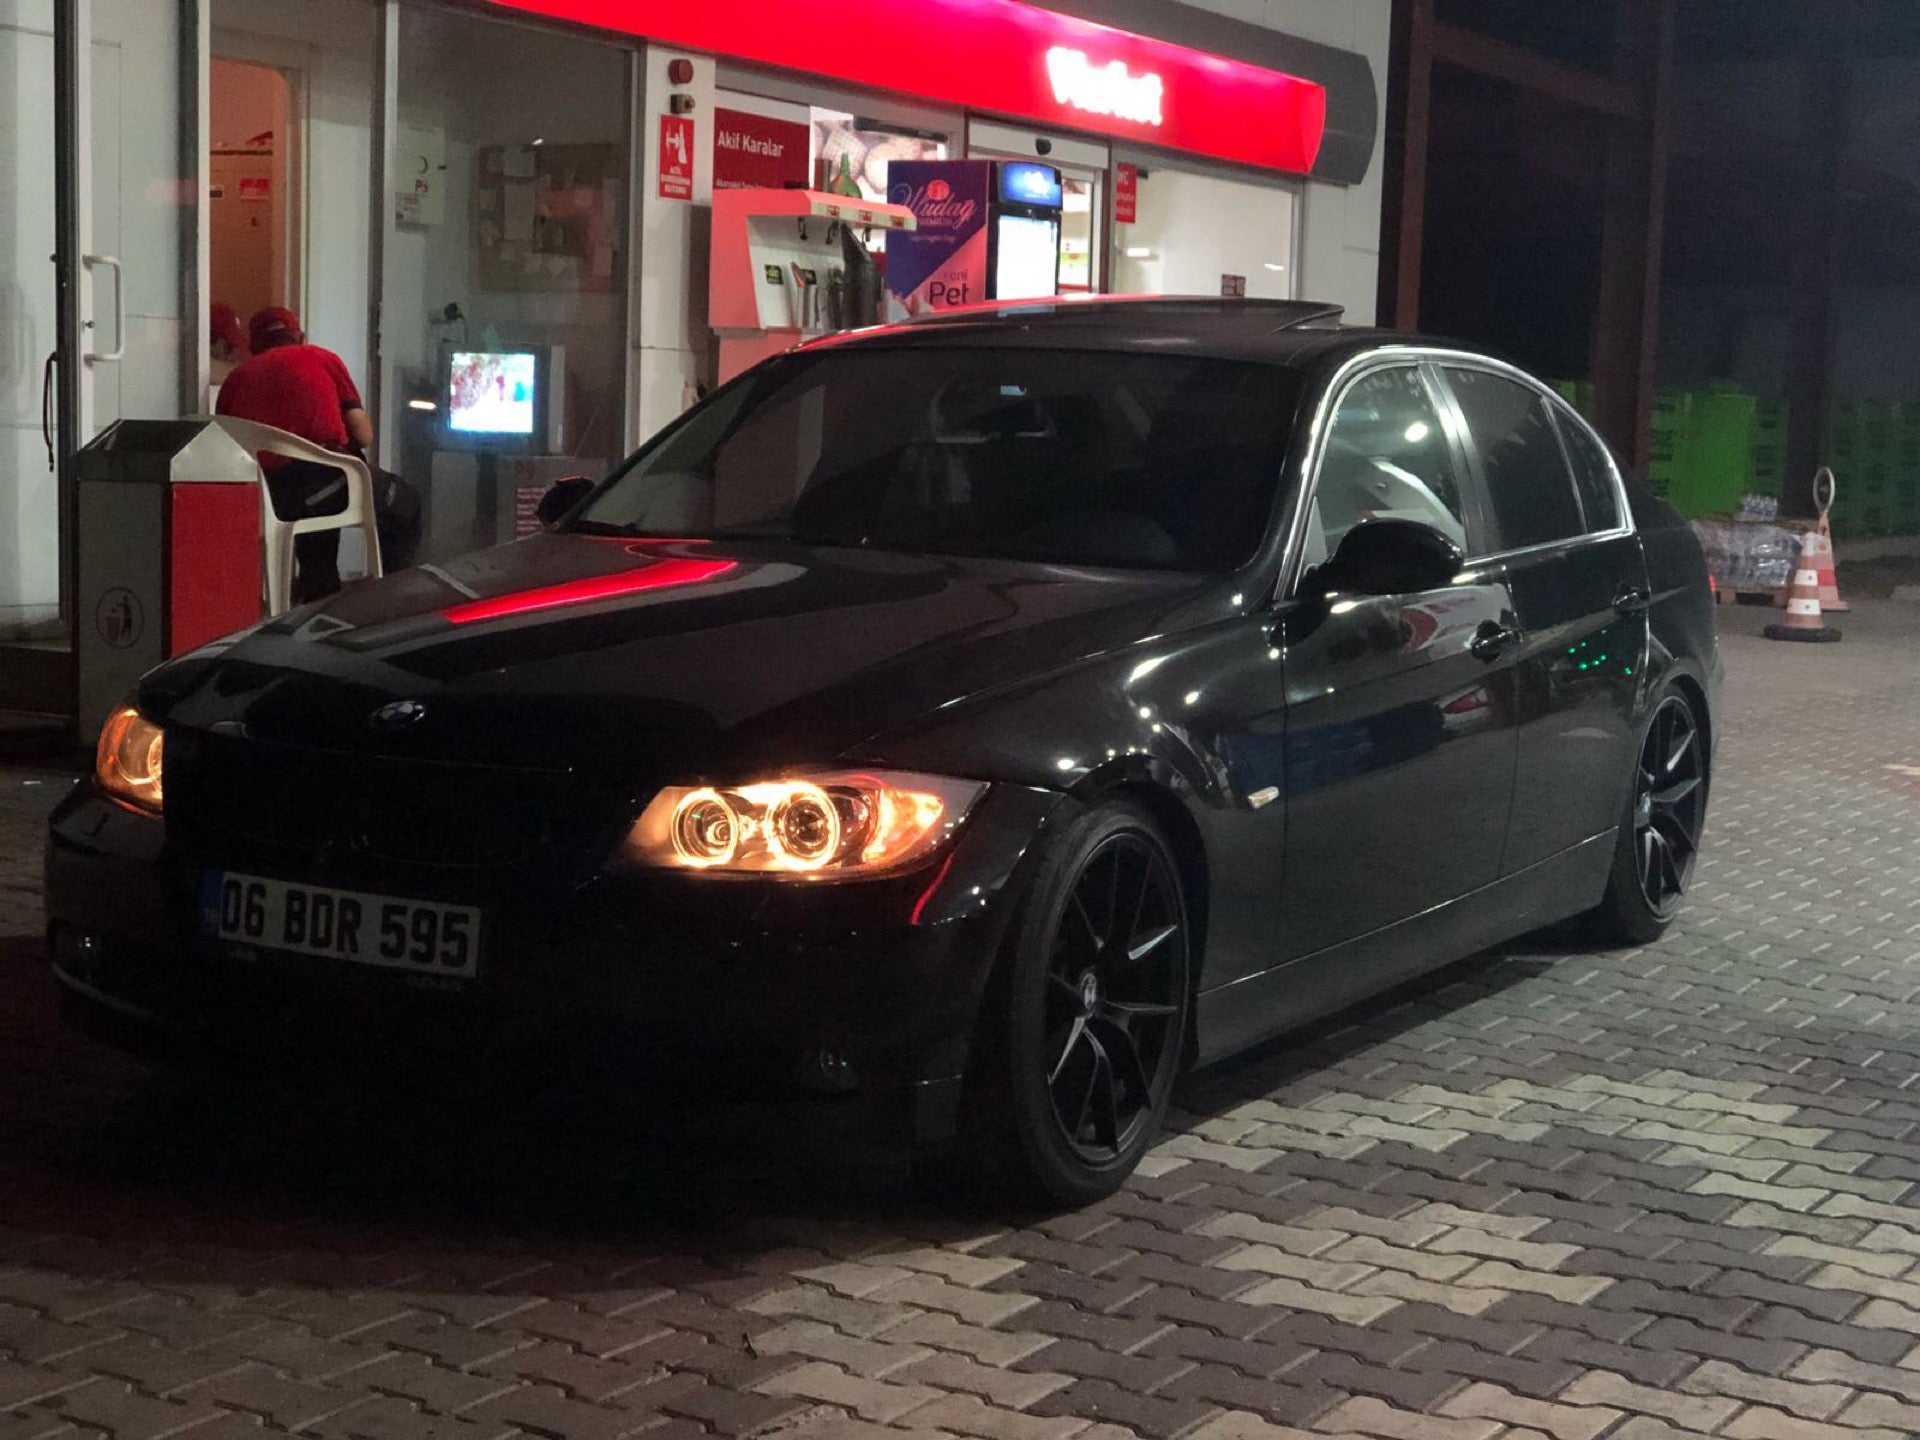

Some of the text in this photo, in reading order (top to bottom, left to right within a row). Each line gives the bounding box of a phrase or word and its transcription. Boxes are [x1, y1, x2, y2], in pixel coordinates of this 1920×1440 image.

[742, 135, 785, 157] Karalar
[929, 281, 970, 306] Pet
[221, 879, 470, 968] 06 BDR 595
